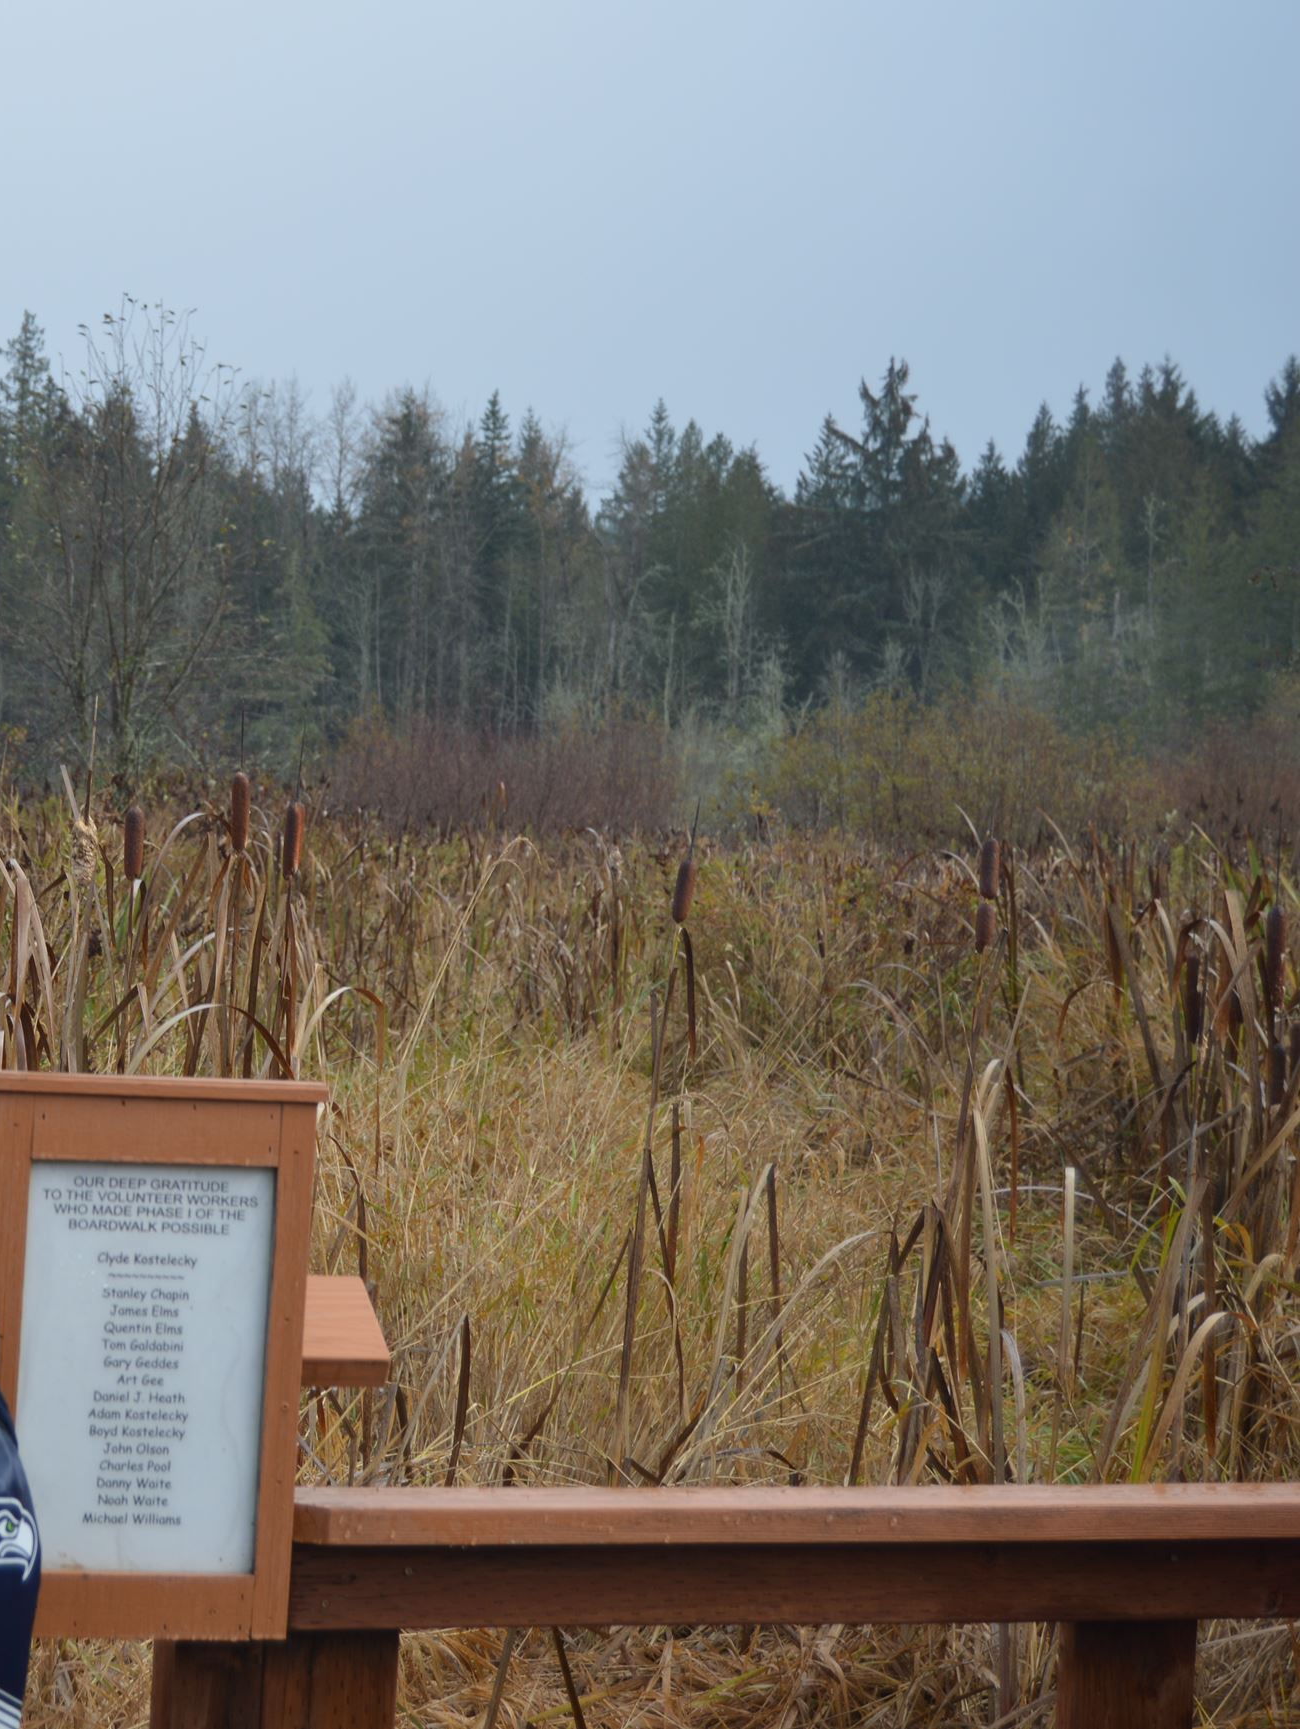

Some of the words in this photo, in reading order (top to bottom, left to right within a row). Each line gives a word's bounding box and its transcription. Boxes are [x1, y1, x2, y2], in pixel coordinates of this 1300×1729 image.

[73, 1176, 104, 1188] OUR
[109, 1177, 146, 1189] DEEP
[150, 1180, 229, 1192] GRATITUDE
[43, 1189, 62, 1200] TO
[66, 1190, 92, 1201] THE
[97, 1191, 182, 1204] VOLUNTEER
[187, 1195, 258, 1208] WORKERS
[54, 1204, 88, 1215] WHO
[92, 1205, 132, 1216] MADE
[136, 1207, 183, 1218] PHASE
[195, 1209, 214, 1219] OF
[219, 1210, 246, 1220] THE
[68, 1219, 157, 1232] BOARDWALK
[161, 1223, 230, 1236] POSSIBLE
[97, 1252, 130, 1267] Clyde
[134, 1254, 198, 1270] Kostelecky
[102, 1288, 146, 1301] Stanley
[150, 1288, 189, 1302] Chapin
[110, 1305, 148, 1317] James
[152, 1306, 179, 1318] Elms
[104, 1322, 152, 1335] Quentin
[156, 1323, 183, 1336] Elms
[102, 1339, 126, 1351] Tom
[103, 1357, 131, 1370] Gary
[136, 1358, 179, 1370] Geddes
[117, 1374, 137, 1386] Art
[142, 1375, 164, 1386] Gee
[93, 1390, 130, 1402] Daniel
[149, 1392, 185, 1404] Heath
[88, 1408, 121, 1420] Adam
[125, 1409, 188, 1424] Kostelecky
[89, 1426, 118, 1439] Boyd
[122, 1426, 186, 1441] Kostelecky
[104, 1442, 132, 1454] John
[136, 1443, 170, 1455] Olson
[100, 1460, 144, 1472] Charles
[148, 1460, 171, 1472] Pool
[96, 1477, 132, 1491] Danny
[136, 1478, 172, 1490] Waite
[98, 1494, 128, 1506] Noah
[133, 1495, 168, 1507] Waite
[82, 1513, 128, 1524] Michael
[132, 1514, 180, 1526] Williams
